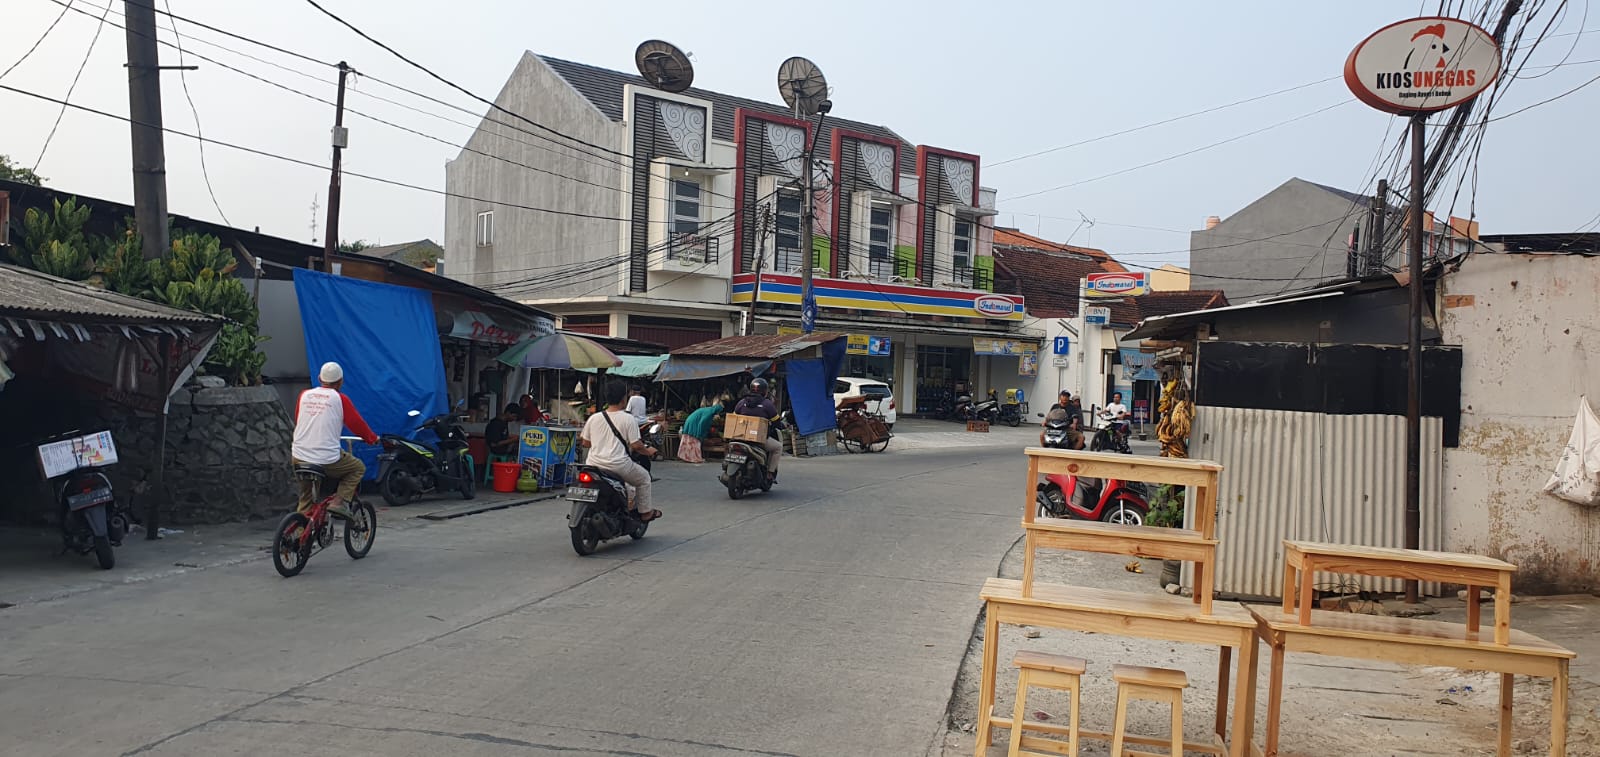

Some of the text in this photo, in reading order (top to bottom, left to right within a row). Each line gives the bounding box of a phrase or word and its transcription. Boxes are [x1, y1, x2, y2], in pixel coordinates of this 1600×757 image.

[1097, 280, 1133, 289] Indomaret
[980, 300, 1011, 312] Indomaret
[1057, 338, 1065, 353] P
[525, 432, 543, 440] PUKIS
